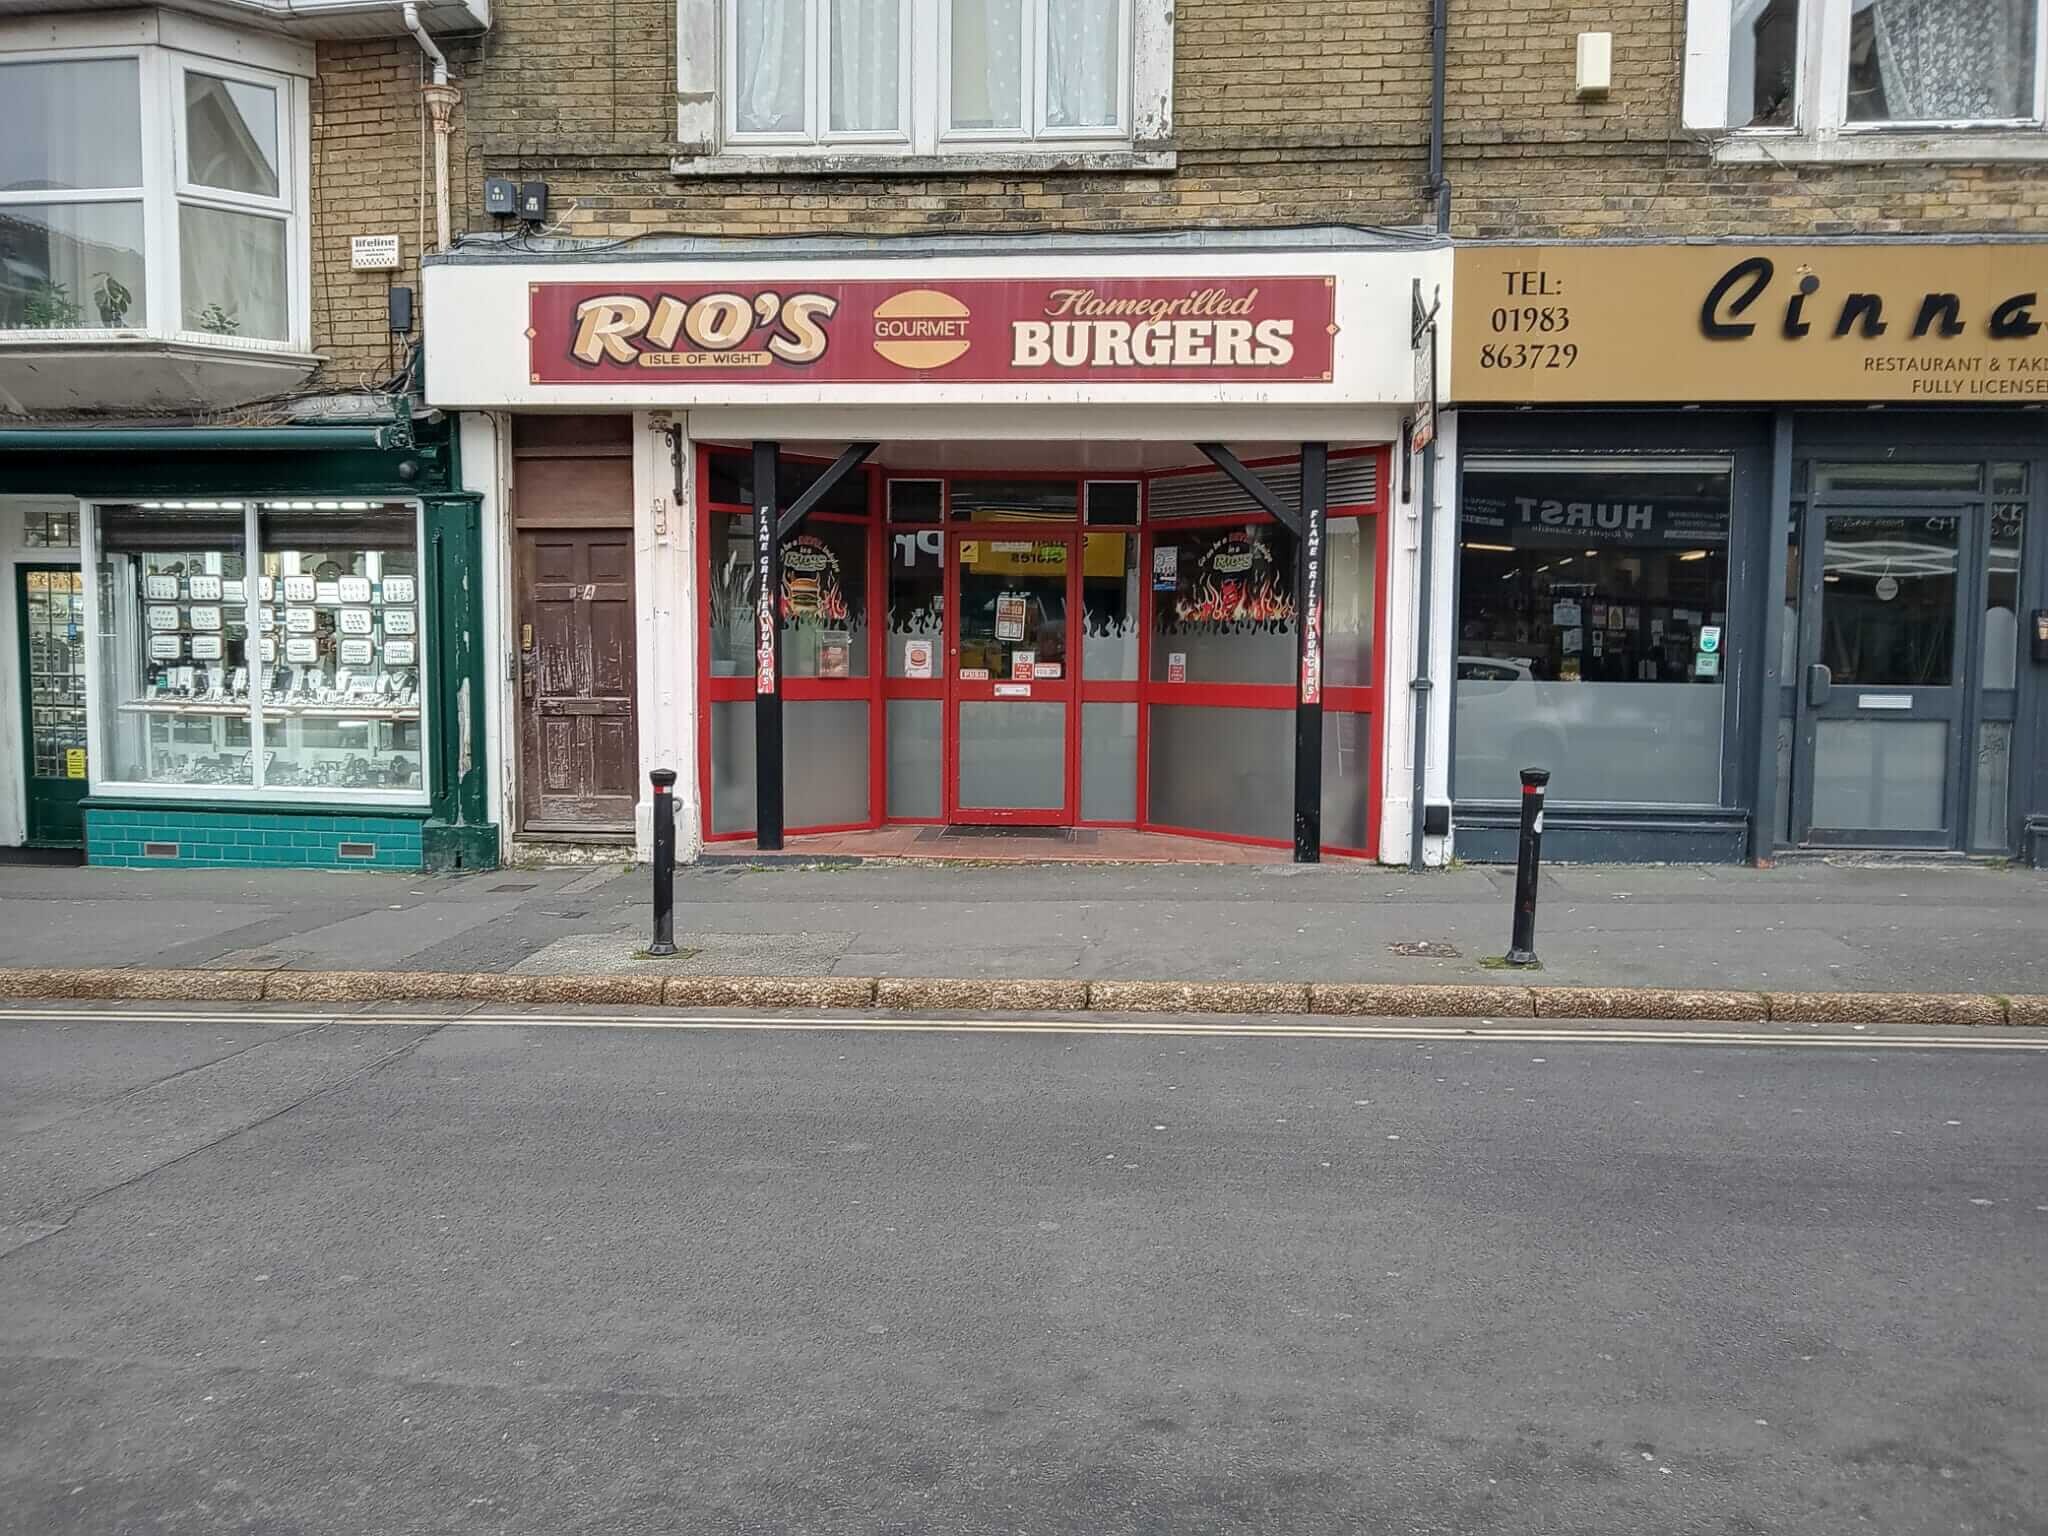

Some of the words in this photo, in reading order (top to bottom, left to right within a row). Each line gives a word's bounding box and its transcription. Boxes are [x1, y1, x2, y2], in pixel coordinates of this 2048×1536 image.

[355, 238, 395, 248] lifeline
[1502, 271, 1563, 296] TEL:
[1700, 256, 2048, 338] Cinna
[1044, 287, 1258, 326] Flamegrilled
[1491, 307, 1570, 332] 01983
[571, 291, 837, 366] RIO'S
[875, 319, 970, 337] GOURMET
[1011, 319, 1294, 367] BURGERS
[1480, 342, 1578, 369] 863729
[648, 353, 682, 365] ISLE
[687, 353, 709, 365] OF
[713, 352, 760, 365] WIGHT
[1864, 356, 1983, 373] RESTAURANT
[1988, 357, 2001, 372] &
[1912, 378, 1964, 394] FULLY
[1970, 378, 2048, 394] LICENSE
[1887, 447, 1896, 458] 7
[759, 506, 770, 551] FLAME
[1308, 510, 1319, 556] FLAME
[761, 624, 769, 685] BURGERS
[1307, 631, 1316, 694] BURGERS
